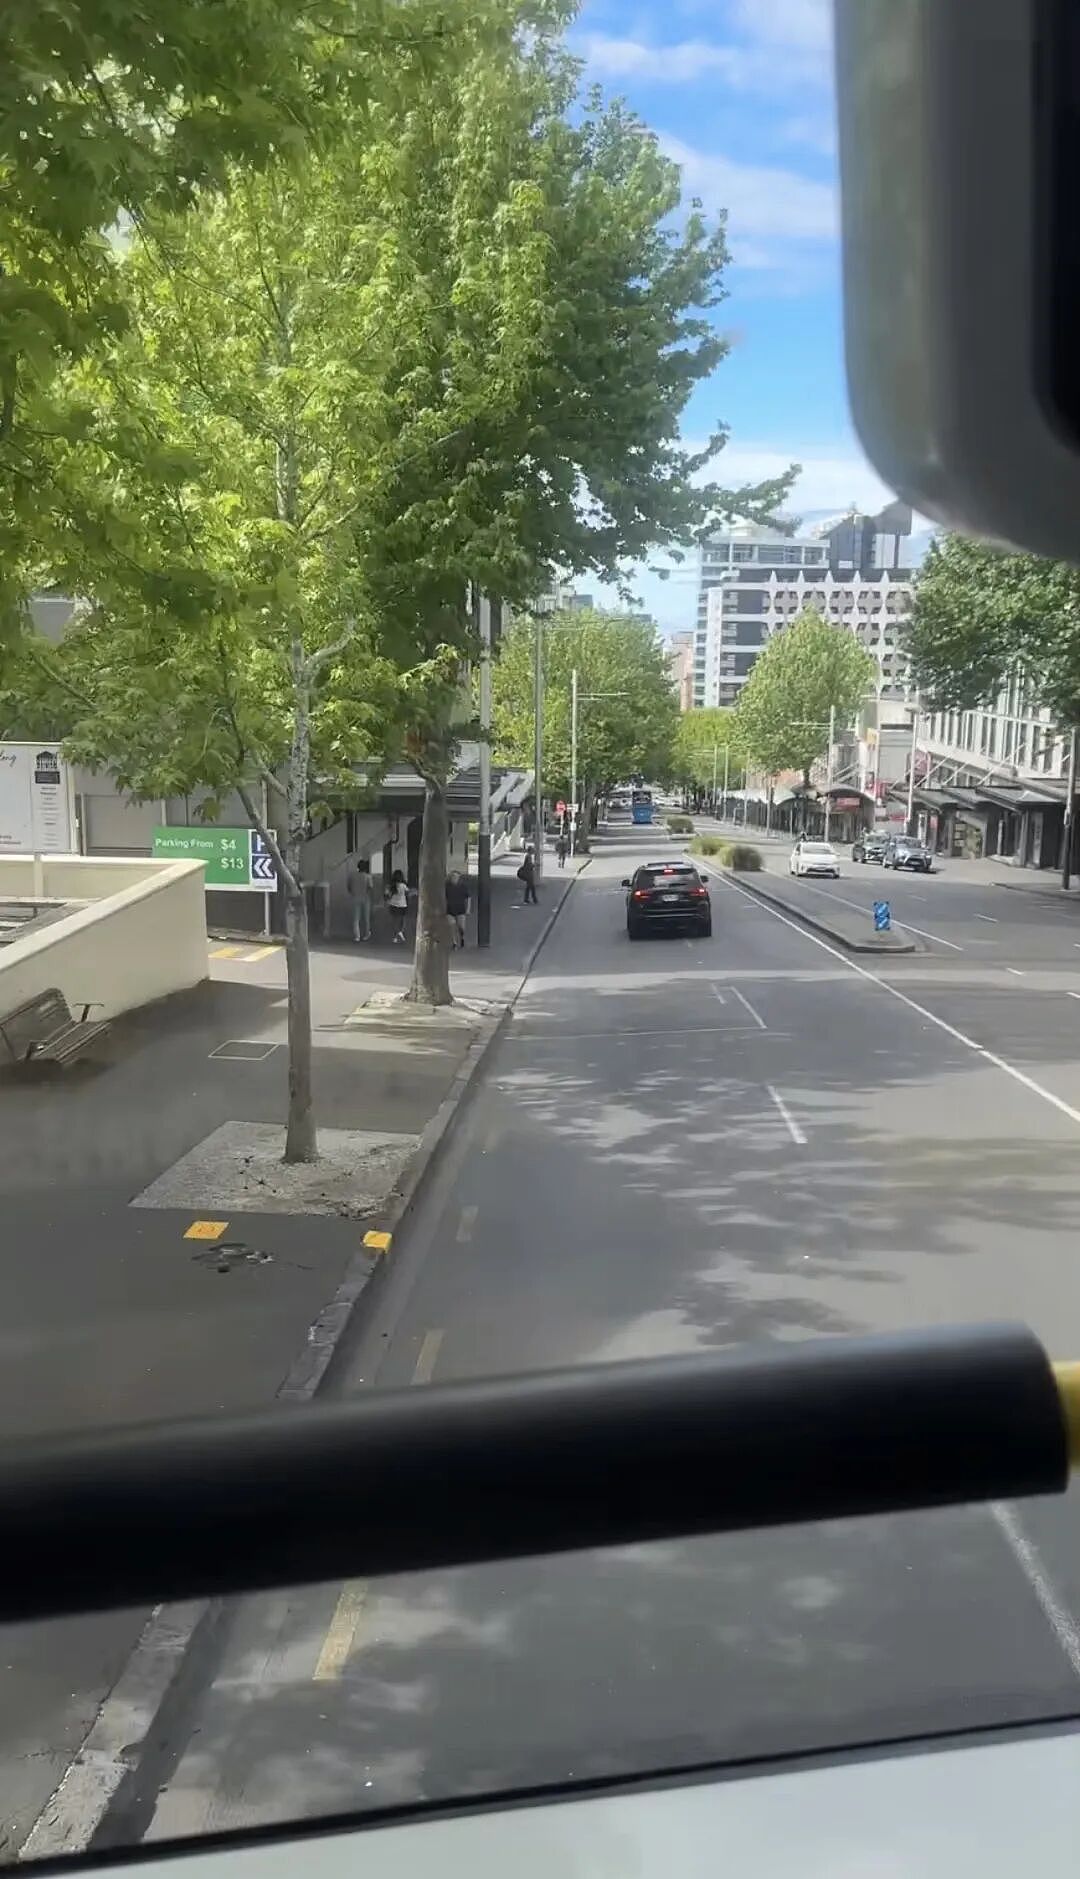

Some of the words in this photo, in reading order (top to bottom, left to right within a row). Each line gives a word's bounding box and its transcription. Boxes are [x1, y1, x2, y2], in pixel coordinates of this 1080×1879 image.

[155, 838, 189, 849] Parking
[190, 838, 214, 849] From
[220, 838, 237, 850] $4
[221, 857, 244, 869] $13
